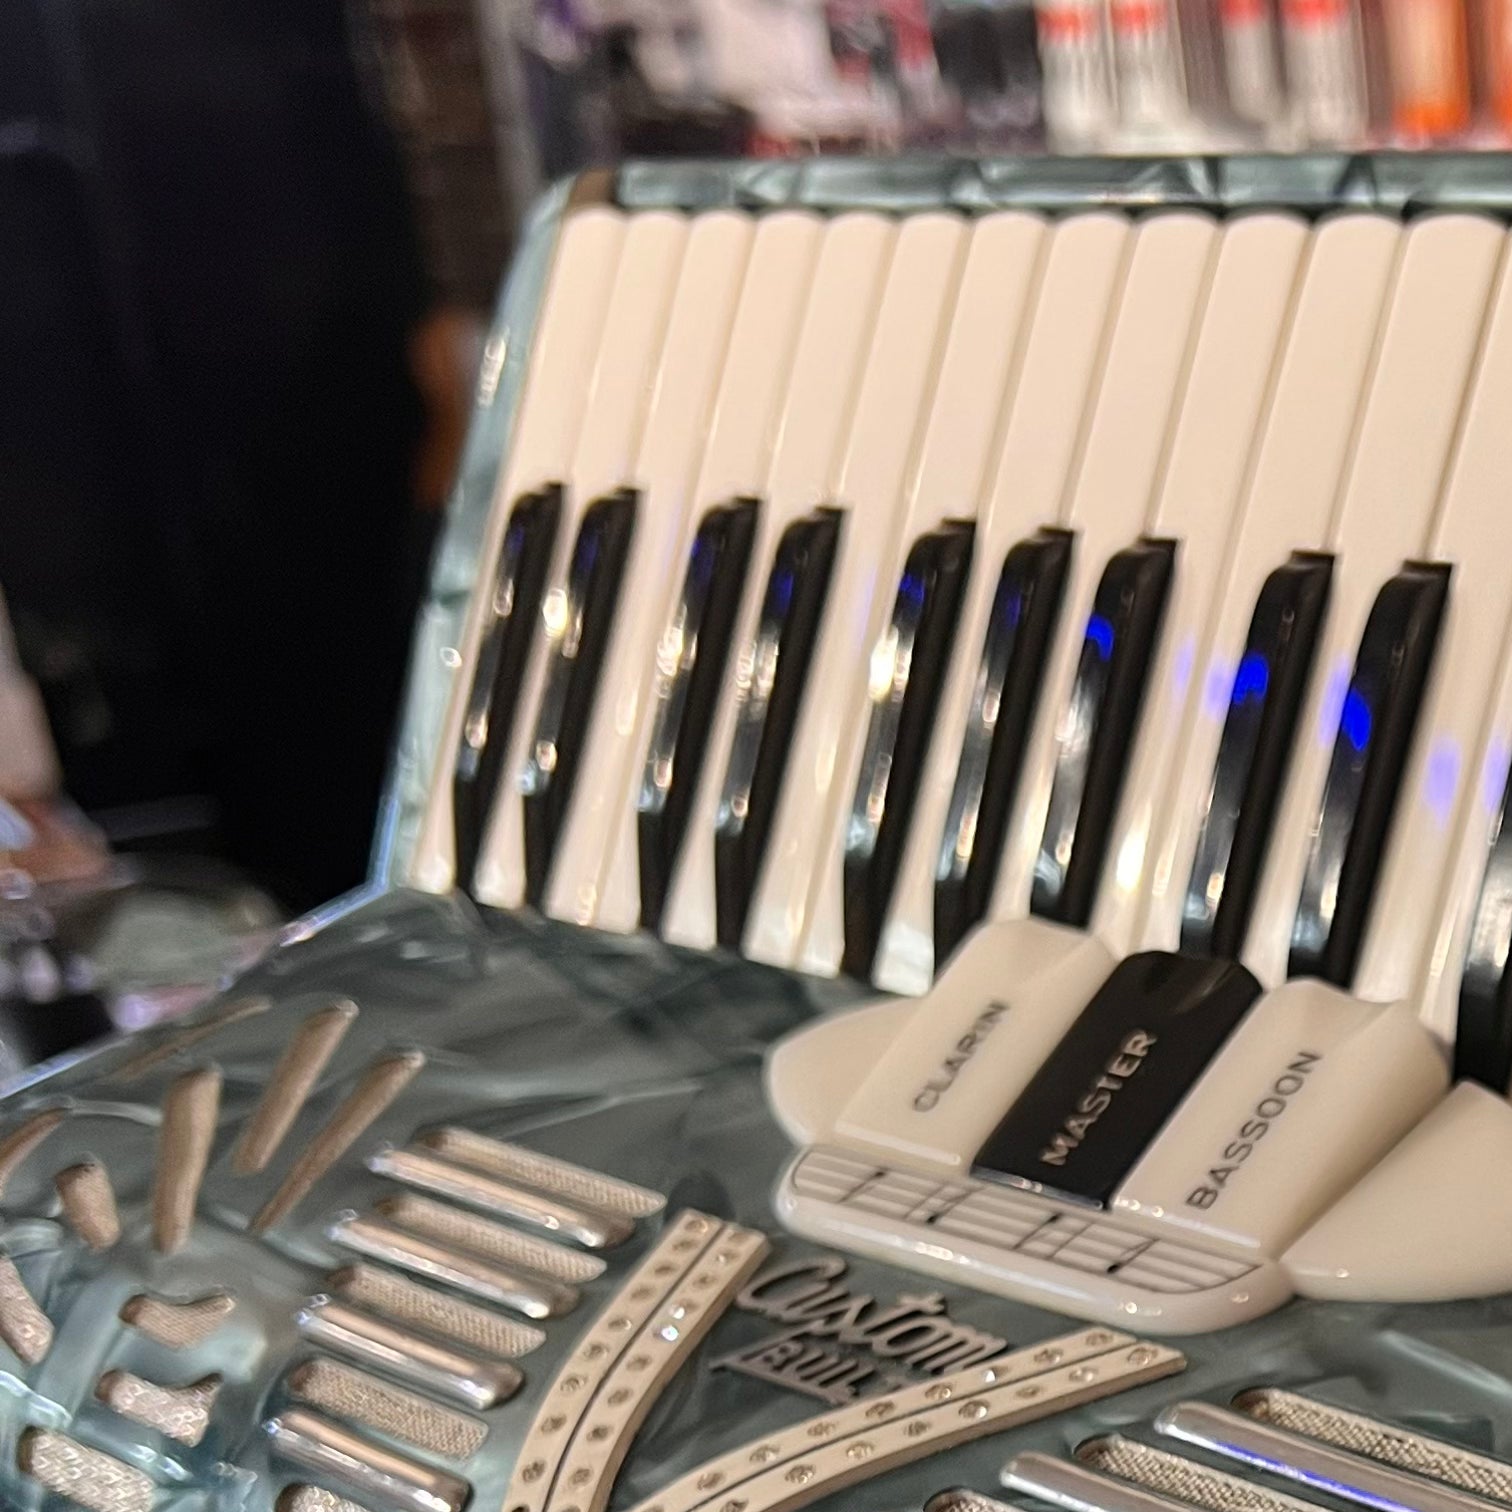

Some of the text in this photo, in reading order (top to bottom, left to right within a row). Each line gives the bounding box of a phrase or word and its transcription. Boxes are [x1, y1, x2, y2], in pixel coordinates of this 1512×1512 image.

[1040, 1029, 1157, 1166] MASTER
[1185, 1050, 1322, 1210] BASSOON
[736, 1256, 1009, 1373] Custom
